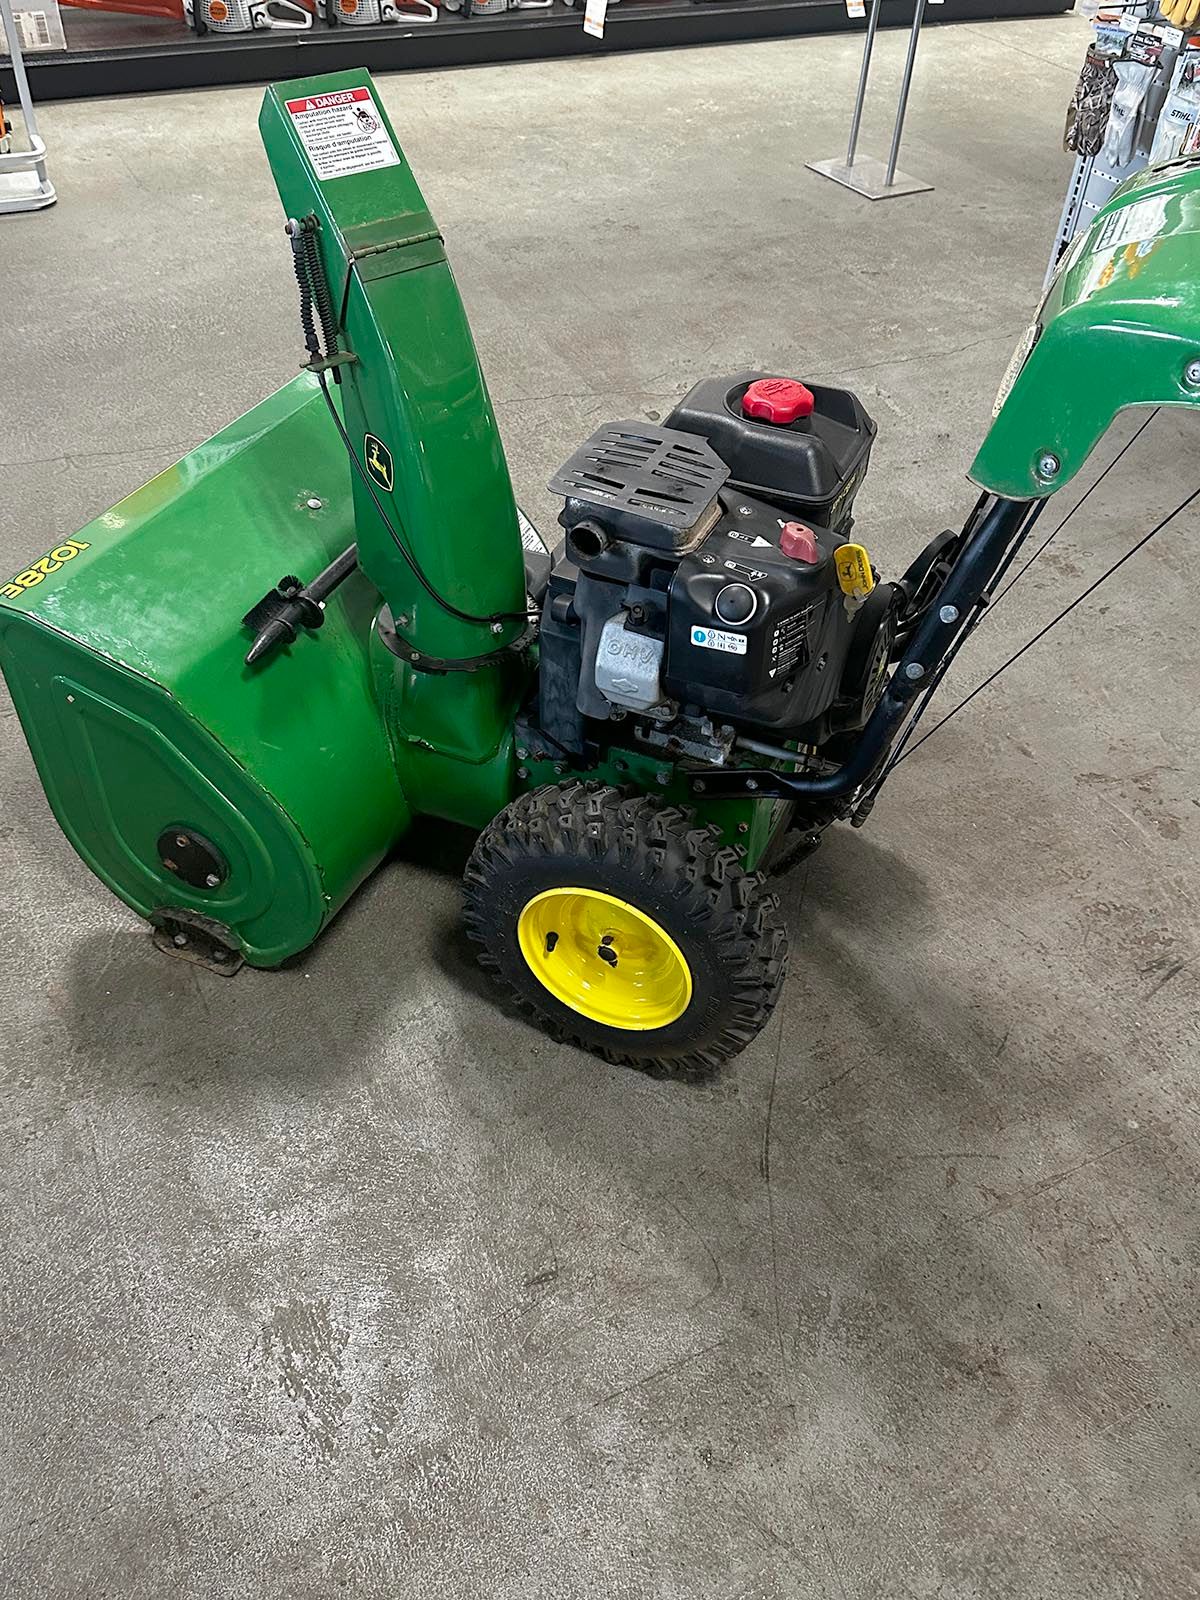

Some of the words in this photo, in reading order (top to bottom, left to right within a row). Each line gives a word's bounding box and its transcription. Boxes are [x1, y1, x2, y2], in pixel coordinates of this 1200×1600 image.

[315, 92, 356, 108] DANGER
[295, 109, 331, 120] Amputation
[332, 104, 353, 113] hazard
[1170, 109, 1192, 121] STIHL
[308, 142, 331, 152] Risque
[0, 539, 92, 600] 1028E
[860, 571, 868, 589] JOHN
[607, 639, 654, 664] OHV
